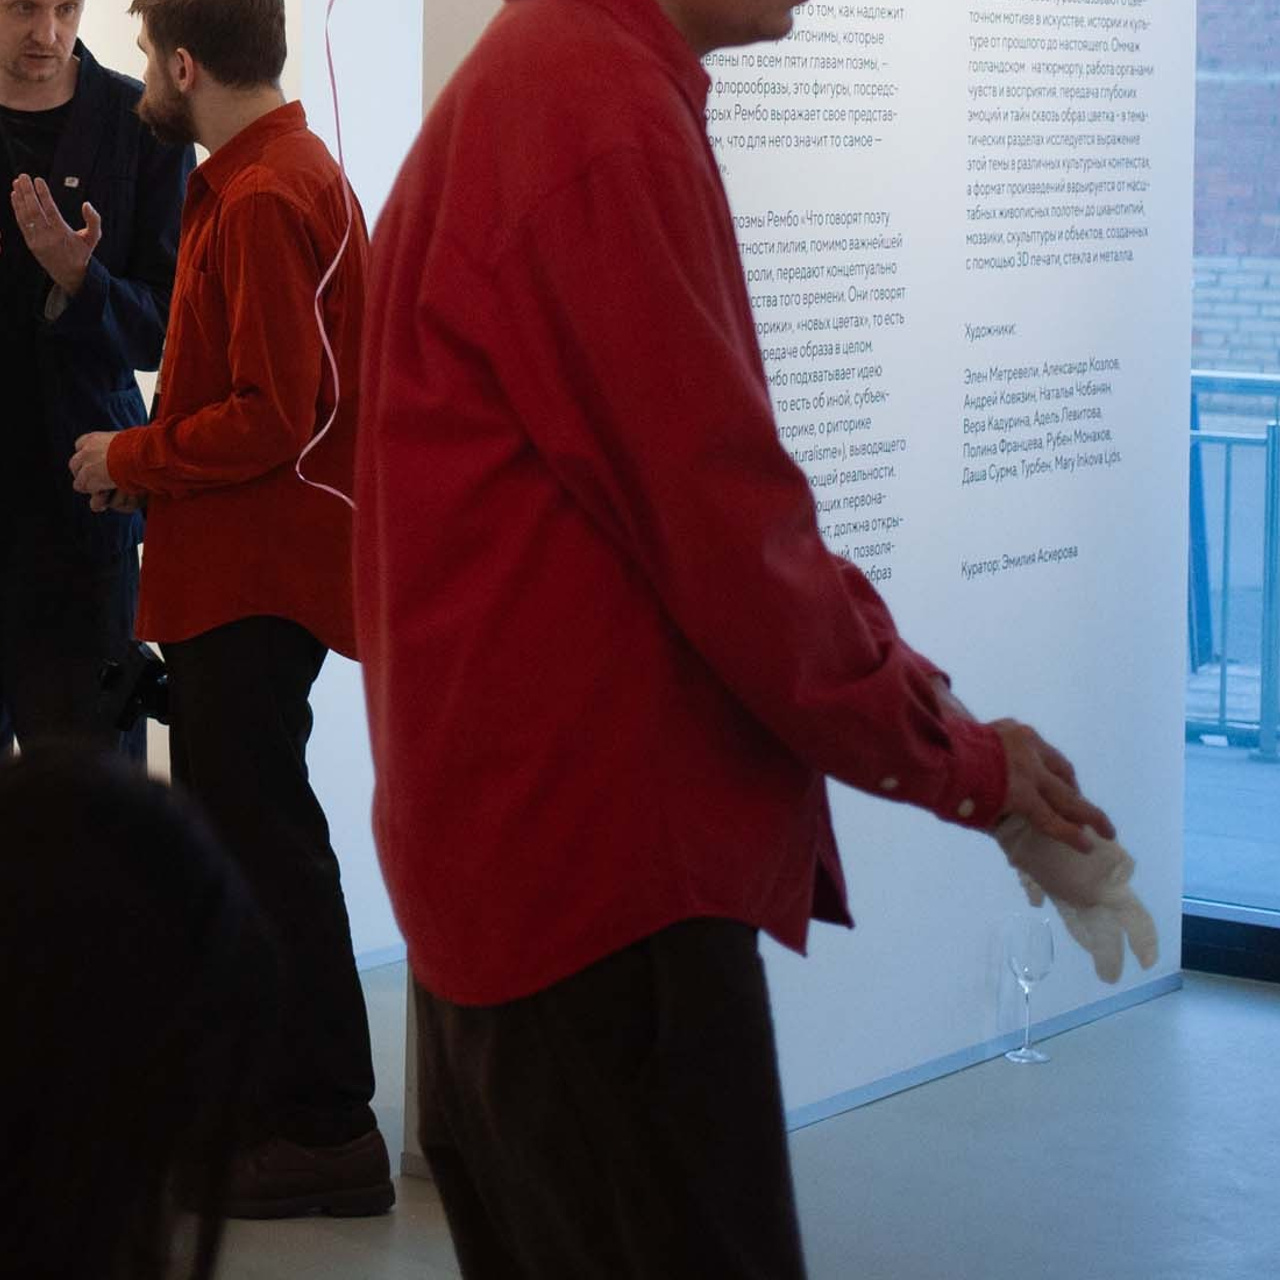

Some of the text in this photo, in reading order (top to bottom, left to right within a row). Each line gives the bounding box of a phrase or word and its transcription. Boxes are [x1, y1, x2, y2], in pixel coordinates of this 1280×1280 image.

[838, 5, 854, 17] как
[856, 6, 904, 20] надлежит
[842, 31, 884, 48] которые
[742, 54, 755, 66] по
[756, 54, 781, 66] всем
[783, 55, 808, 67] пяти
[809, 56, 844, 68] главам
[715, 78, 791, 97] флорообразы,
[793, 82, 810, 94] это
[734, 104, 768, 120] Рембо
[770, 108, 820, 124] выражает
[822, 109, 846, 120] свое
[727, 134, 873, 149] что для него значит то самое
[767, 211, 799, 227] Рембо
[824, 212, 862, 228] говорят
[863, 211, 890, 226] поэту
[810, 238, 848, 251] помимо
[849, 233, 902, 249] важнейшей
[972, 256, 1015, 270] помощью
[1016, 251, 1029, 267] 3D
[776, 265, 825, 283] передают
[826, 262, 897, 278] концептуально
[779, 293, 801, 306] того
[847, 286, 868, 302] Они
[870, 287, 906, 303] говорят
[884, 312, 905, 324] есть
[800, 341, 833, 360] образа
[790, 364, 883, 385] подхватывает идею
[964, 368, 988, 384] Элен
[1042, 360, 1088, 376] Александр
[777, 399, 788, 412] то
[790, 397, 811, 411] есть
[963, 391, 998, 411] Андрей
[1040, 385, 1074, 401] Наталья
[826, 417, 872, 437] риторике
[963, 417, 986, 437] Вера
[1033, 409, 1060, 427] Адель
[850, 438, 907, 456] выводящего
[963, 442, 997, 458] Полина
[1046, 431, 1072, 451] Рубен
[962, 466, 987, 485] Даша
[1054, 454, 1076, 472] Mary
[834, 519, 870, 537] должна
[1002, 553, 1036, 570] Эмилия
[1037, 545, 1078, 564] Аскерова
